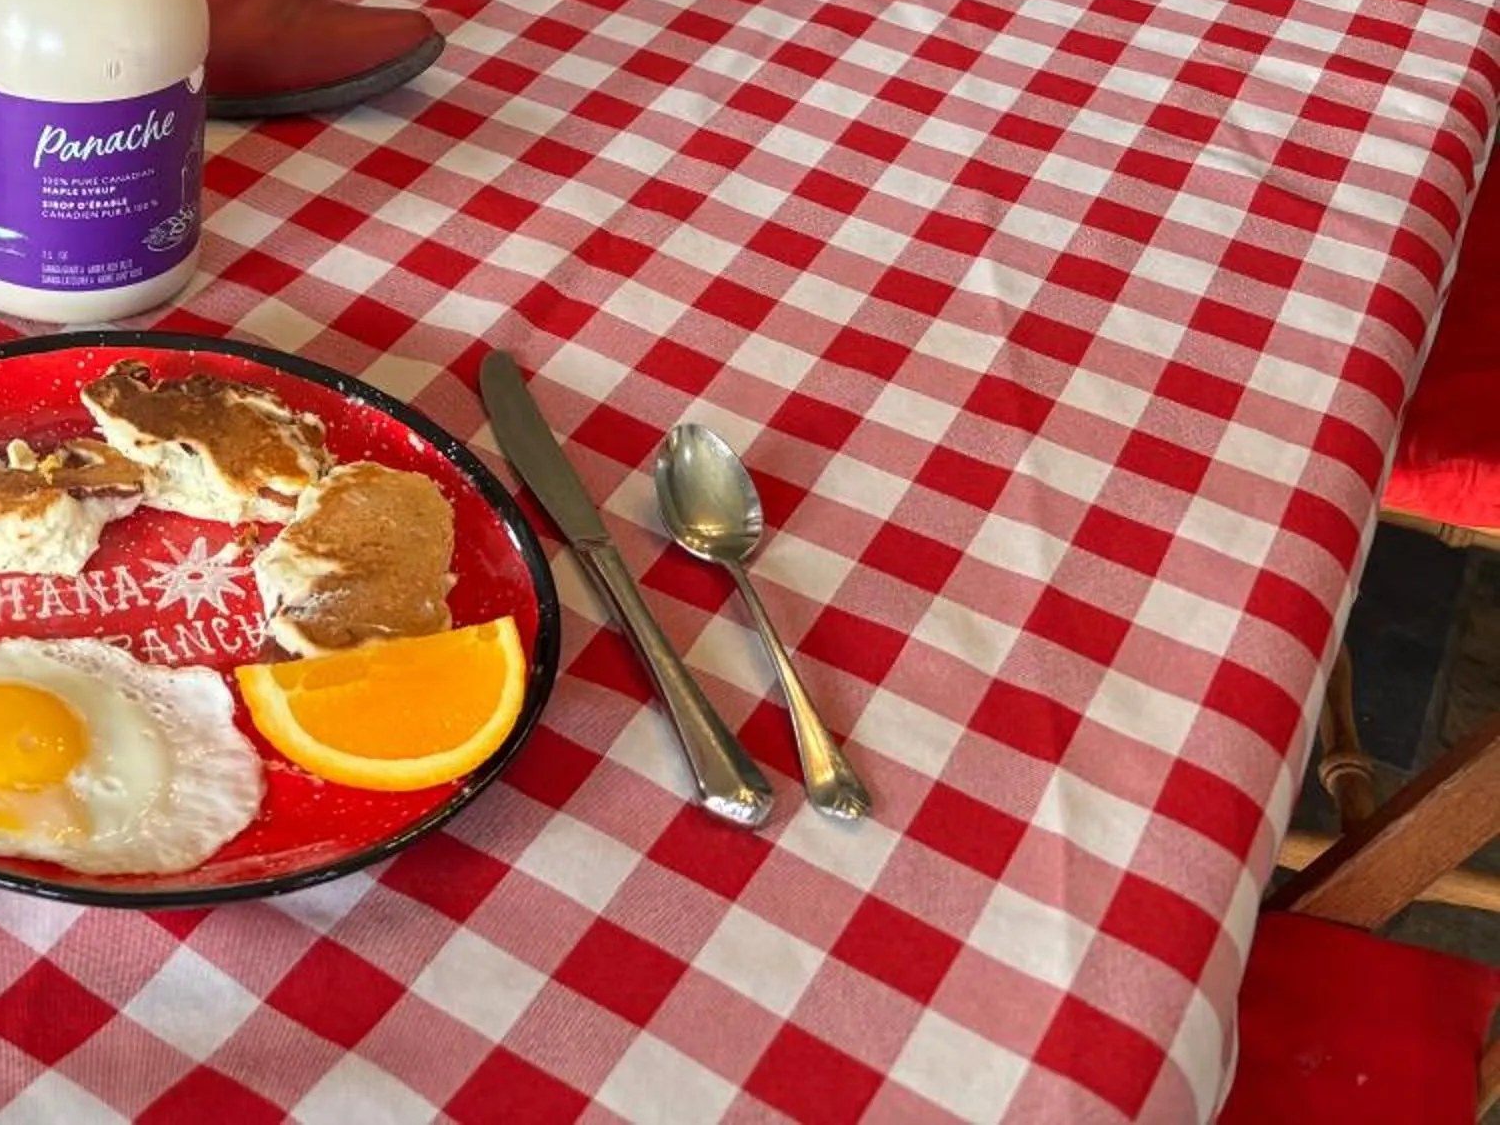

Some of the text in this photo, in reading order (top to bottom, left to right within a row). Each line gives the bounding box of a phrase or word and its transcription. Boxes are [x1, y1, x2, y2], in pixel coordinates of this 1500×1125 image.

[33, 108, 176, 169] Panache
[71, 177, 99, 186] PURE
[101, 168, 156, 184] CANADIAN
[41, 185, 117, 196] MAPLE SYRUP
[41, 209, 100, 220] CANADIEN
